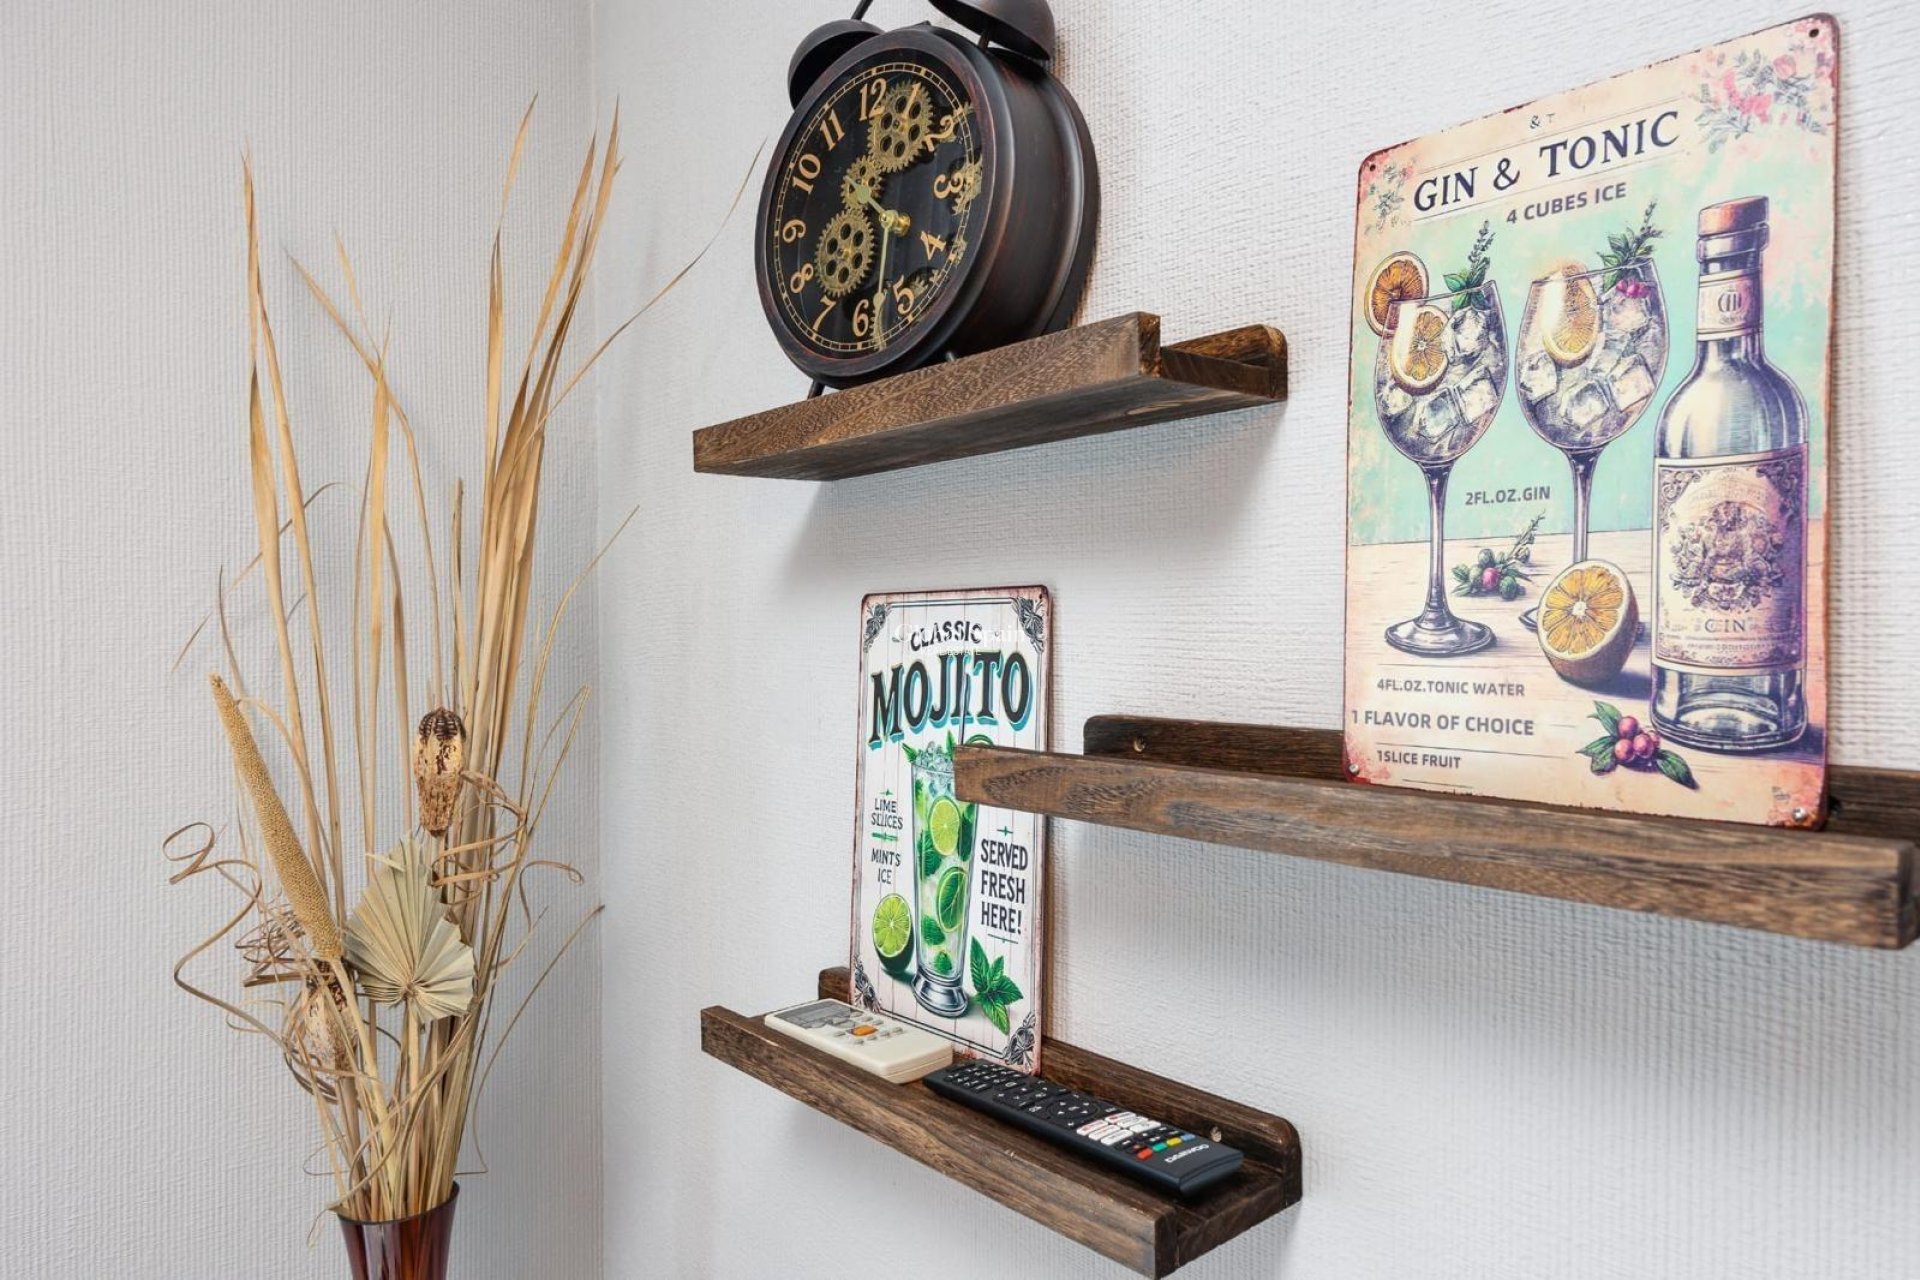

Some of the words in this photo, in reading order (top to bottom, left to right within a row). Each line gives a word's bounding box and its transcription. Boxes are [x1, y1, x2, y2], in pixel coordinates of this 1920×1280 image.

[858, 78, 888, 122] 12
[901, 82, 922, 117] 1
[819, 109, 846, 151] 11
[923, 114, 955, 152] 2
[792, 153, 821, 195] 10
[1414, 166, 1479, 212] GIN
[1492, 157, 1521, 191] &
[1538, 111, 1680, 178] TONIC
[933, 173, 964, 200] 3
[1506, 209, 1518, 224] 4
[1524, 191, 1588, 221] CUBES
[1595, 182, 1628, 205] ICE
[782, 218, 807, 244] 9
[920, 230, 947, 261] 4
[790, 262, 814, 293] 8
[892, 274, 915, 314] 5
[812, 295, 836, 332] 7
[852, 299, 870, 337] 6
[1464, 485, 1552, 506] 2FL.OZ.GIN
[909, 620, 983, 651] CLASSIC
[868, 651, 1032, 748] MOJITO
[1377, 679, 1469, 695] 4FL.OZ.TONIC
[1473, 682, 1526, 697] WATER
[1351, 710, 1359, 724] 1
[1364, 710, 1432, 729] FLAVOR
[1436, 715, 1460, 731] OF
[1465, 716, 1535, 736] CHOICE
[1377, 750, 1418, 765] 1SLICE
[1422, 754, 1462, 769] FRUIT
[874, 798, 897, 813] LIME
[871, 848, 902, 868] MINTS
[980, 838, 1029, 871] SERVED
[877, 868, 893, 885] ICE
[980, 870, 1026, 905] FRESH
[980, 901, 1023, 935] HERE!
